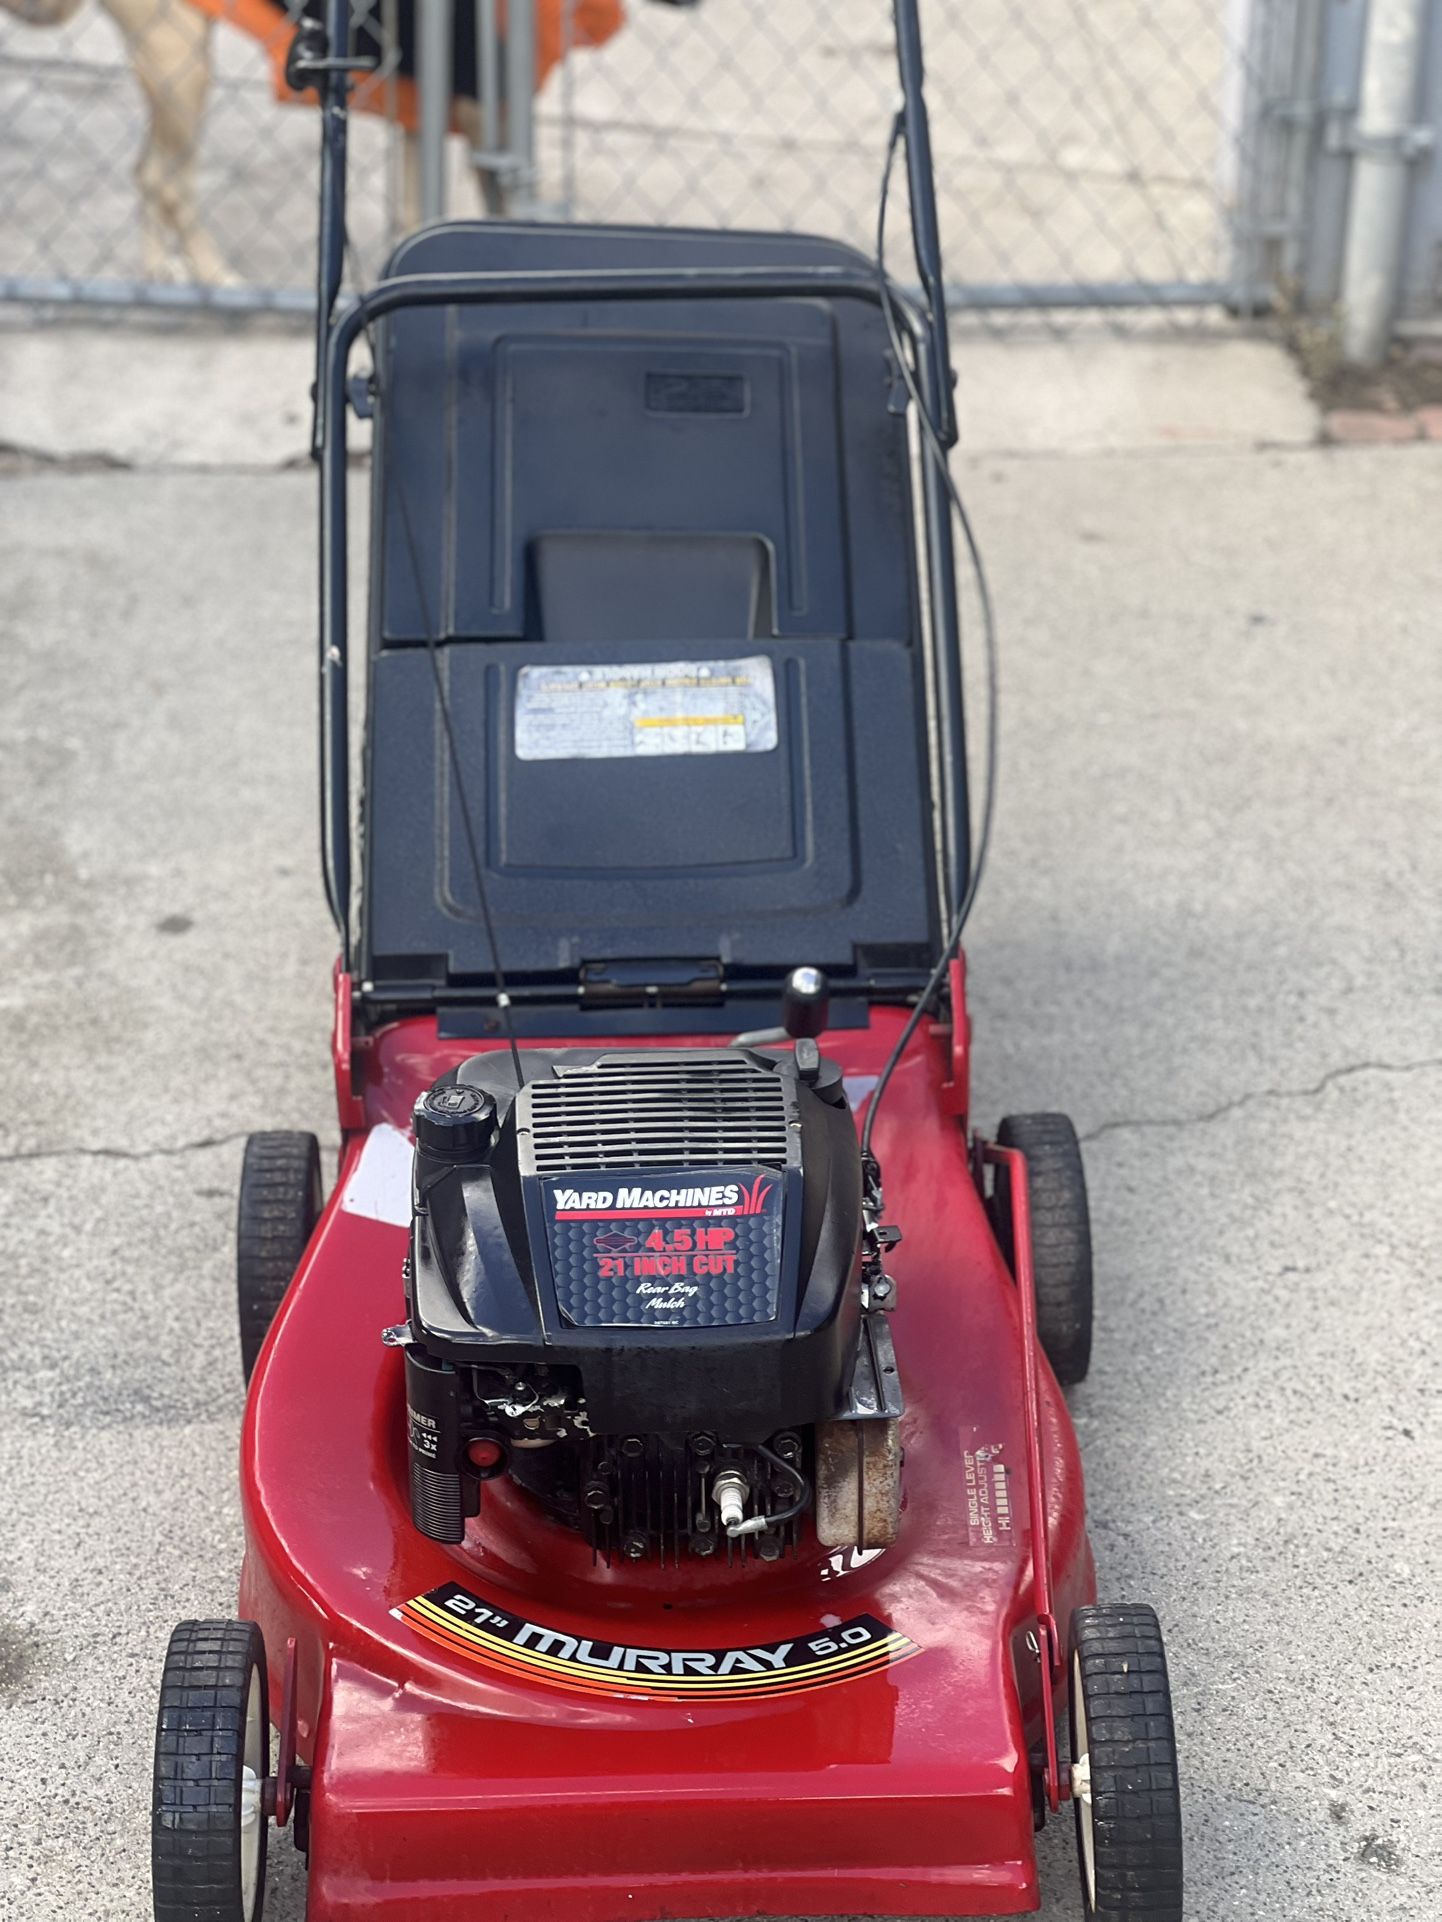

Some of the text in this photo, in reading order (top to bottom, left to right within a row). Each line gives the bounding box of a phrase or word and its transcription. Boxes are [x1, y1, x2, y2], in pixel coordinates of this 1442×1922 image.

[553, 1184, 739, 1210] YARD MACHINES
[713, 1207, 736, 1216] MTD
[645, 1228, 735, 1251] 4.5 HP
[598, 1255, 736, 1277] 21 INCH CUT
[636, 1282, 699, 1297] Rear Bag
[645, 1297, 686, 1309] Mulch
[968, 1488, 980, 1525] SINGLE
[977, 1460, 993, 1544] HEIGHT ADJUST
[998, 1516, 1011, 1531] HI
[512, 1622, 795, 1675] MURRAY
[808, 1626, 872, 1657] 5.0
